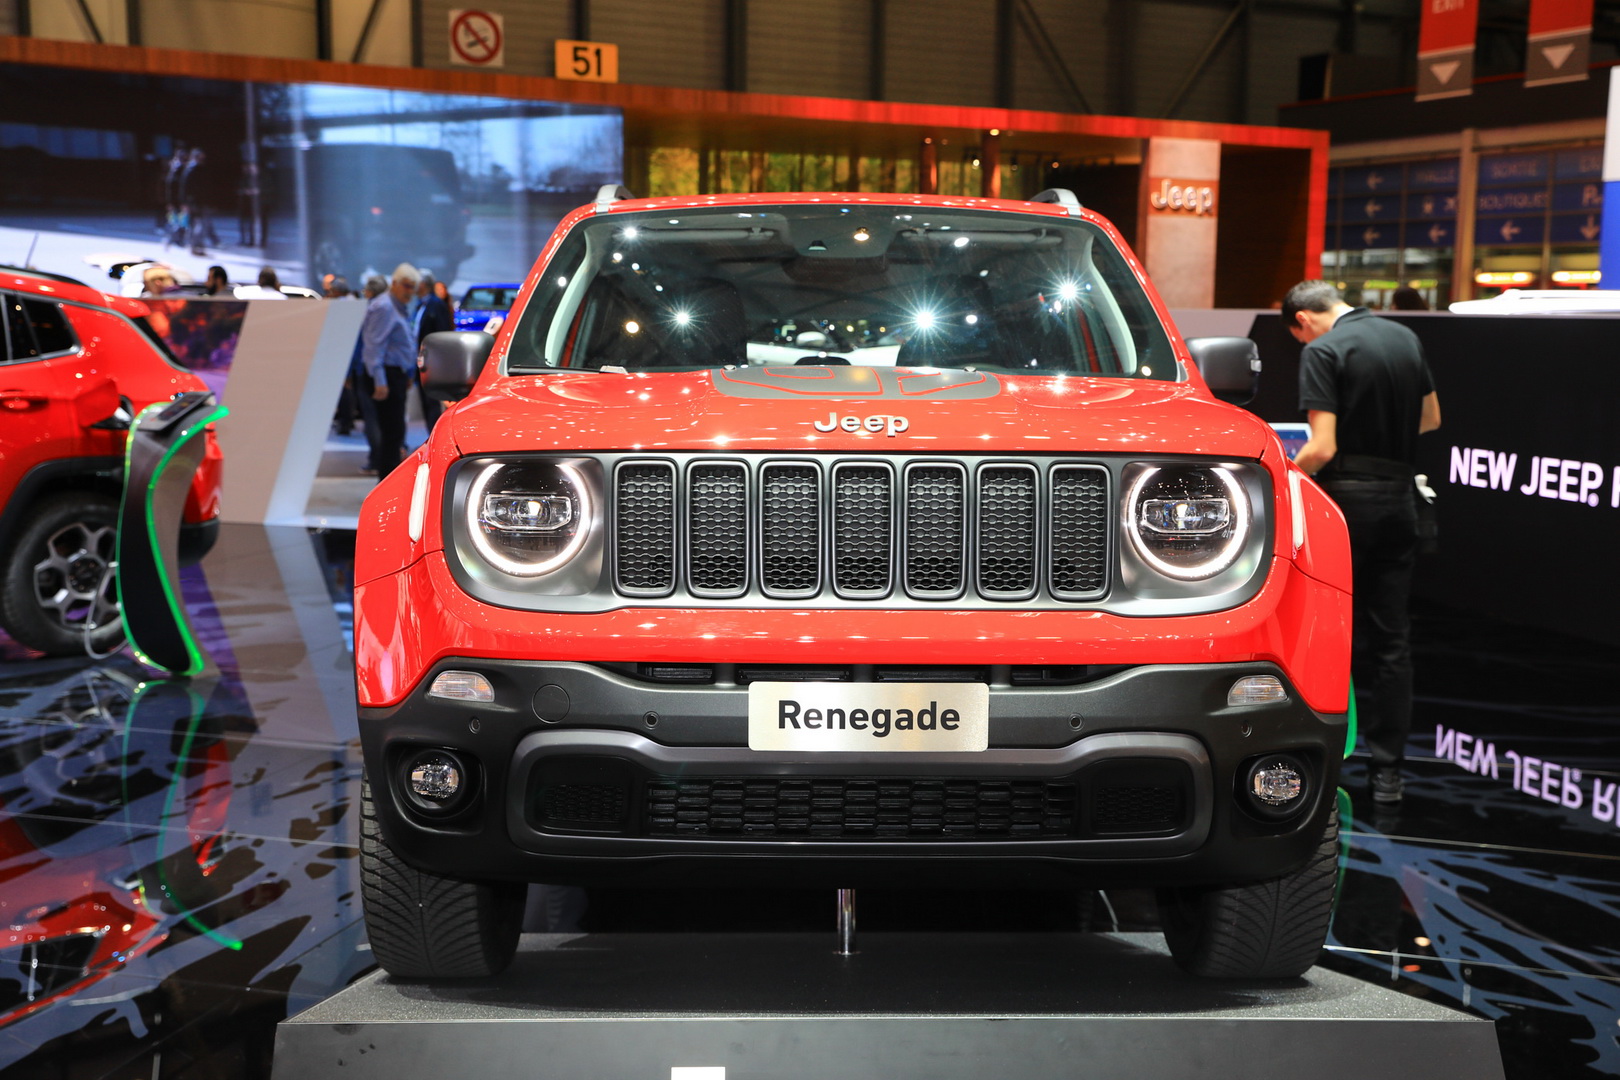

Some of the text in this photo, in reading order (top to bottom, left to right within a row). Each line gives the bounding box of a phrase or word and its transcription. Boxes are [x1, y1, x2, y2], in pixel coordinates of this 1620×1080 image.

[572, 46, 602, 76] 51
[1150, 178, 1213, 214] Jeep
[814, 412, 909, 437] Jeep
[1450, 446, 1518, 491] NEW
[778, 700, 960, 737] Renegade
